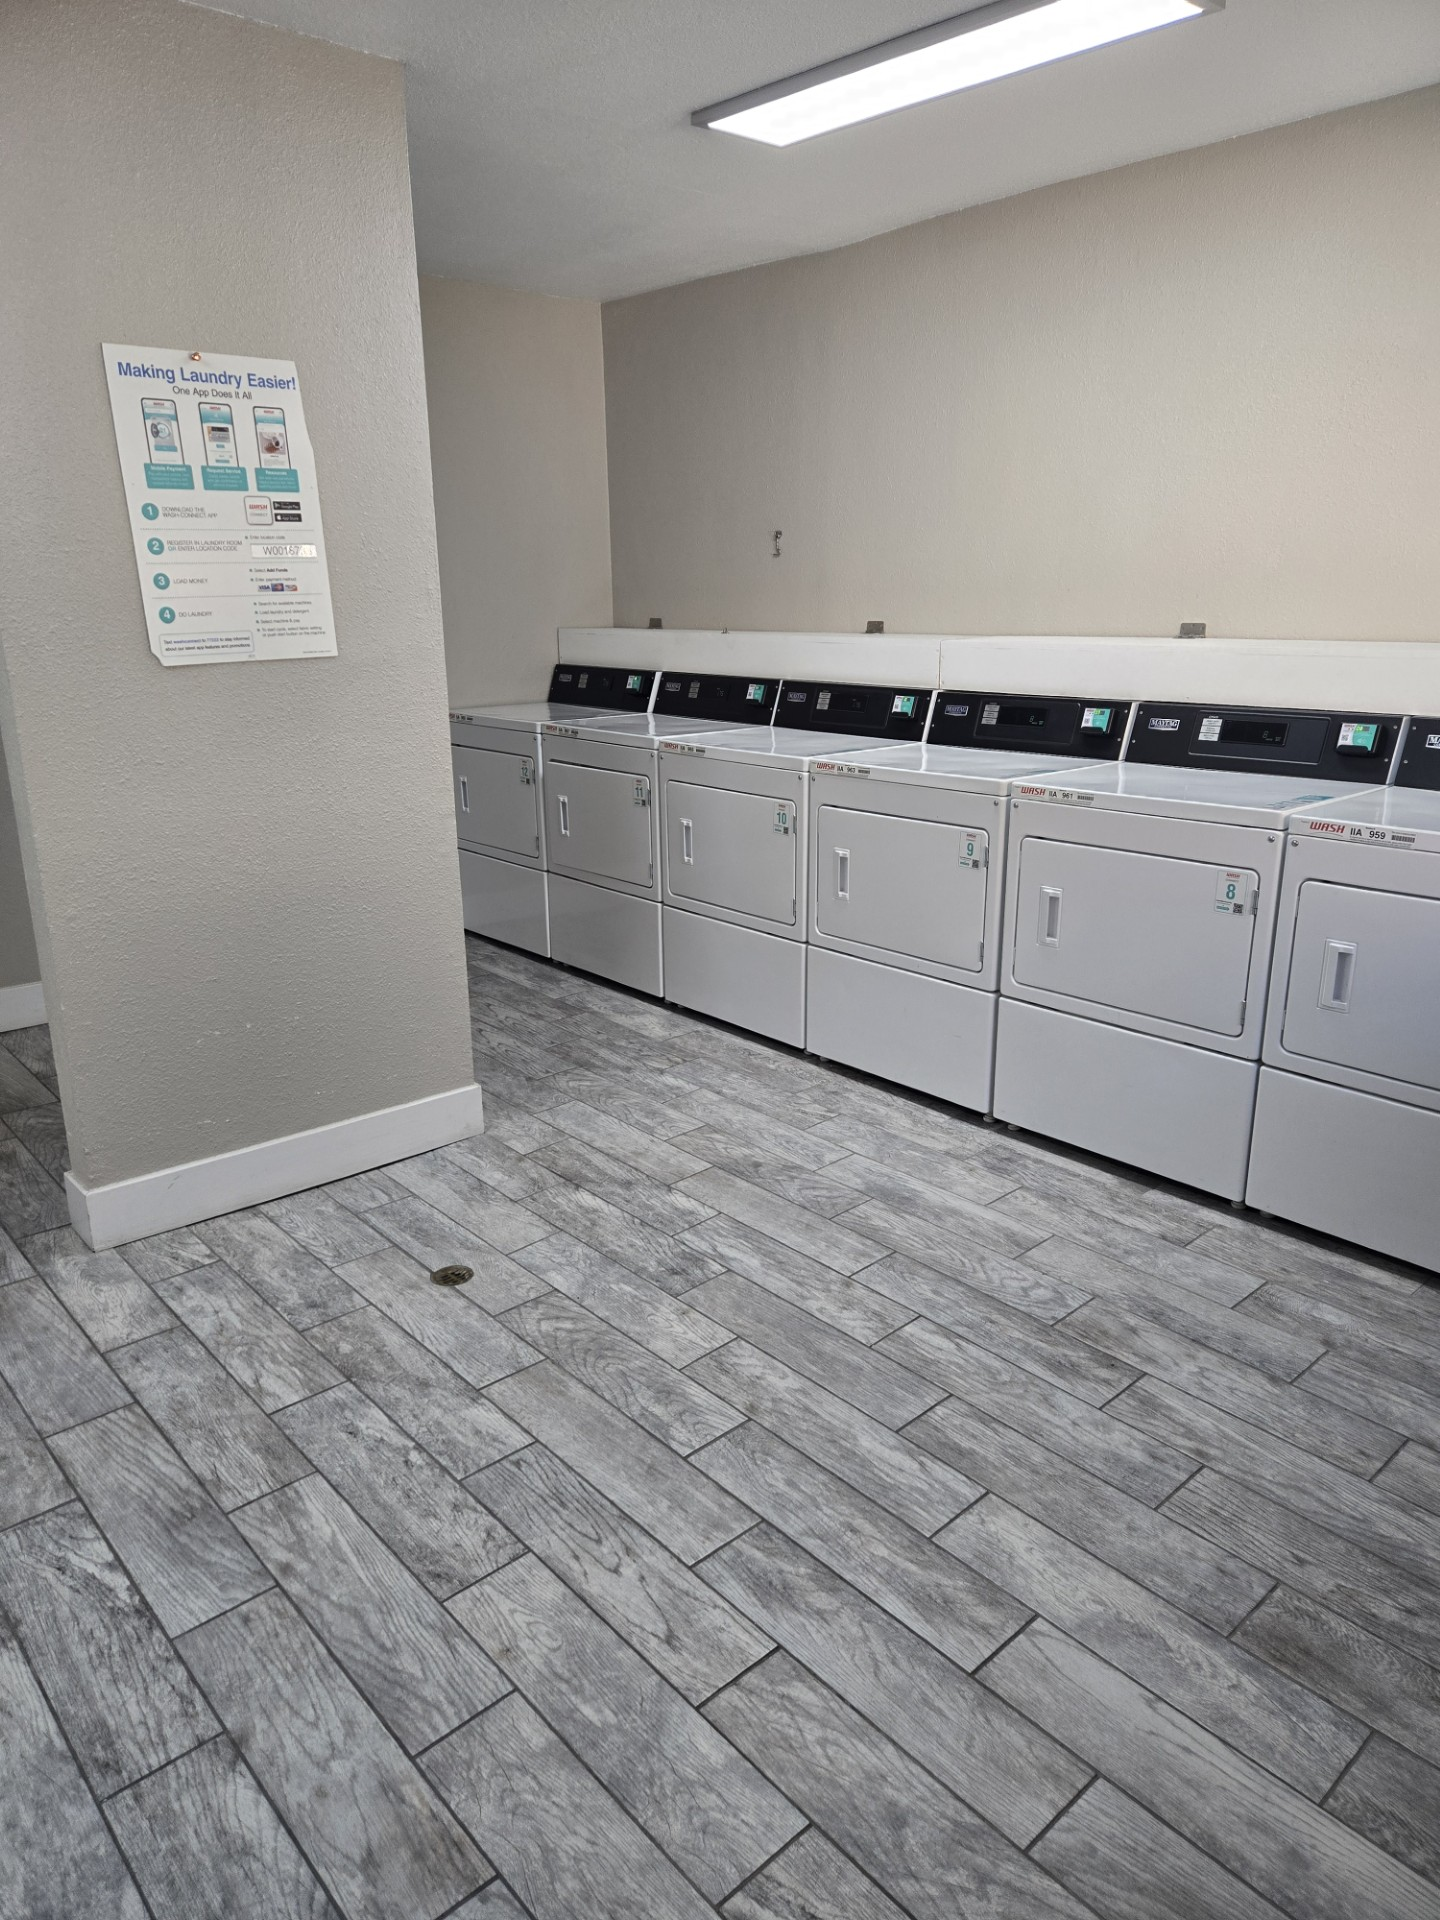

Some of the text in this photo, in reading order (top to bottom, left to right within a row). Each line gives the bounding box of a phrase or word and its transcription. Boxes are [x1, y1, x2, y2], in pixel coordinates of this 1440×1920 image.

[117, 361, 296, 390] Making Laundry Easier!
[172, 385, 252, 400] One App Does It All
[147, 506, 153, 515] 1
[152, 541, 160, 550] 2
[158, 576, 165, 586] 3
[163, 609, 170, 619] 4
[1150, 719, 1179, 727] MAYTAG
[816, 762, 836, 770] WASH
[521, 767, 528, 777] 12
[635, 786, 643, 798] 11
[1021, 786, 1046, 796] WASH
[776, 811, 787, 825] 10
[1310, 821, 1346, 834] WASH
[1369, 830, 1386, 840] 959
[966, 842, 974, 856] 9
[1225, 883, 1236, 900] 8
